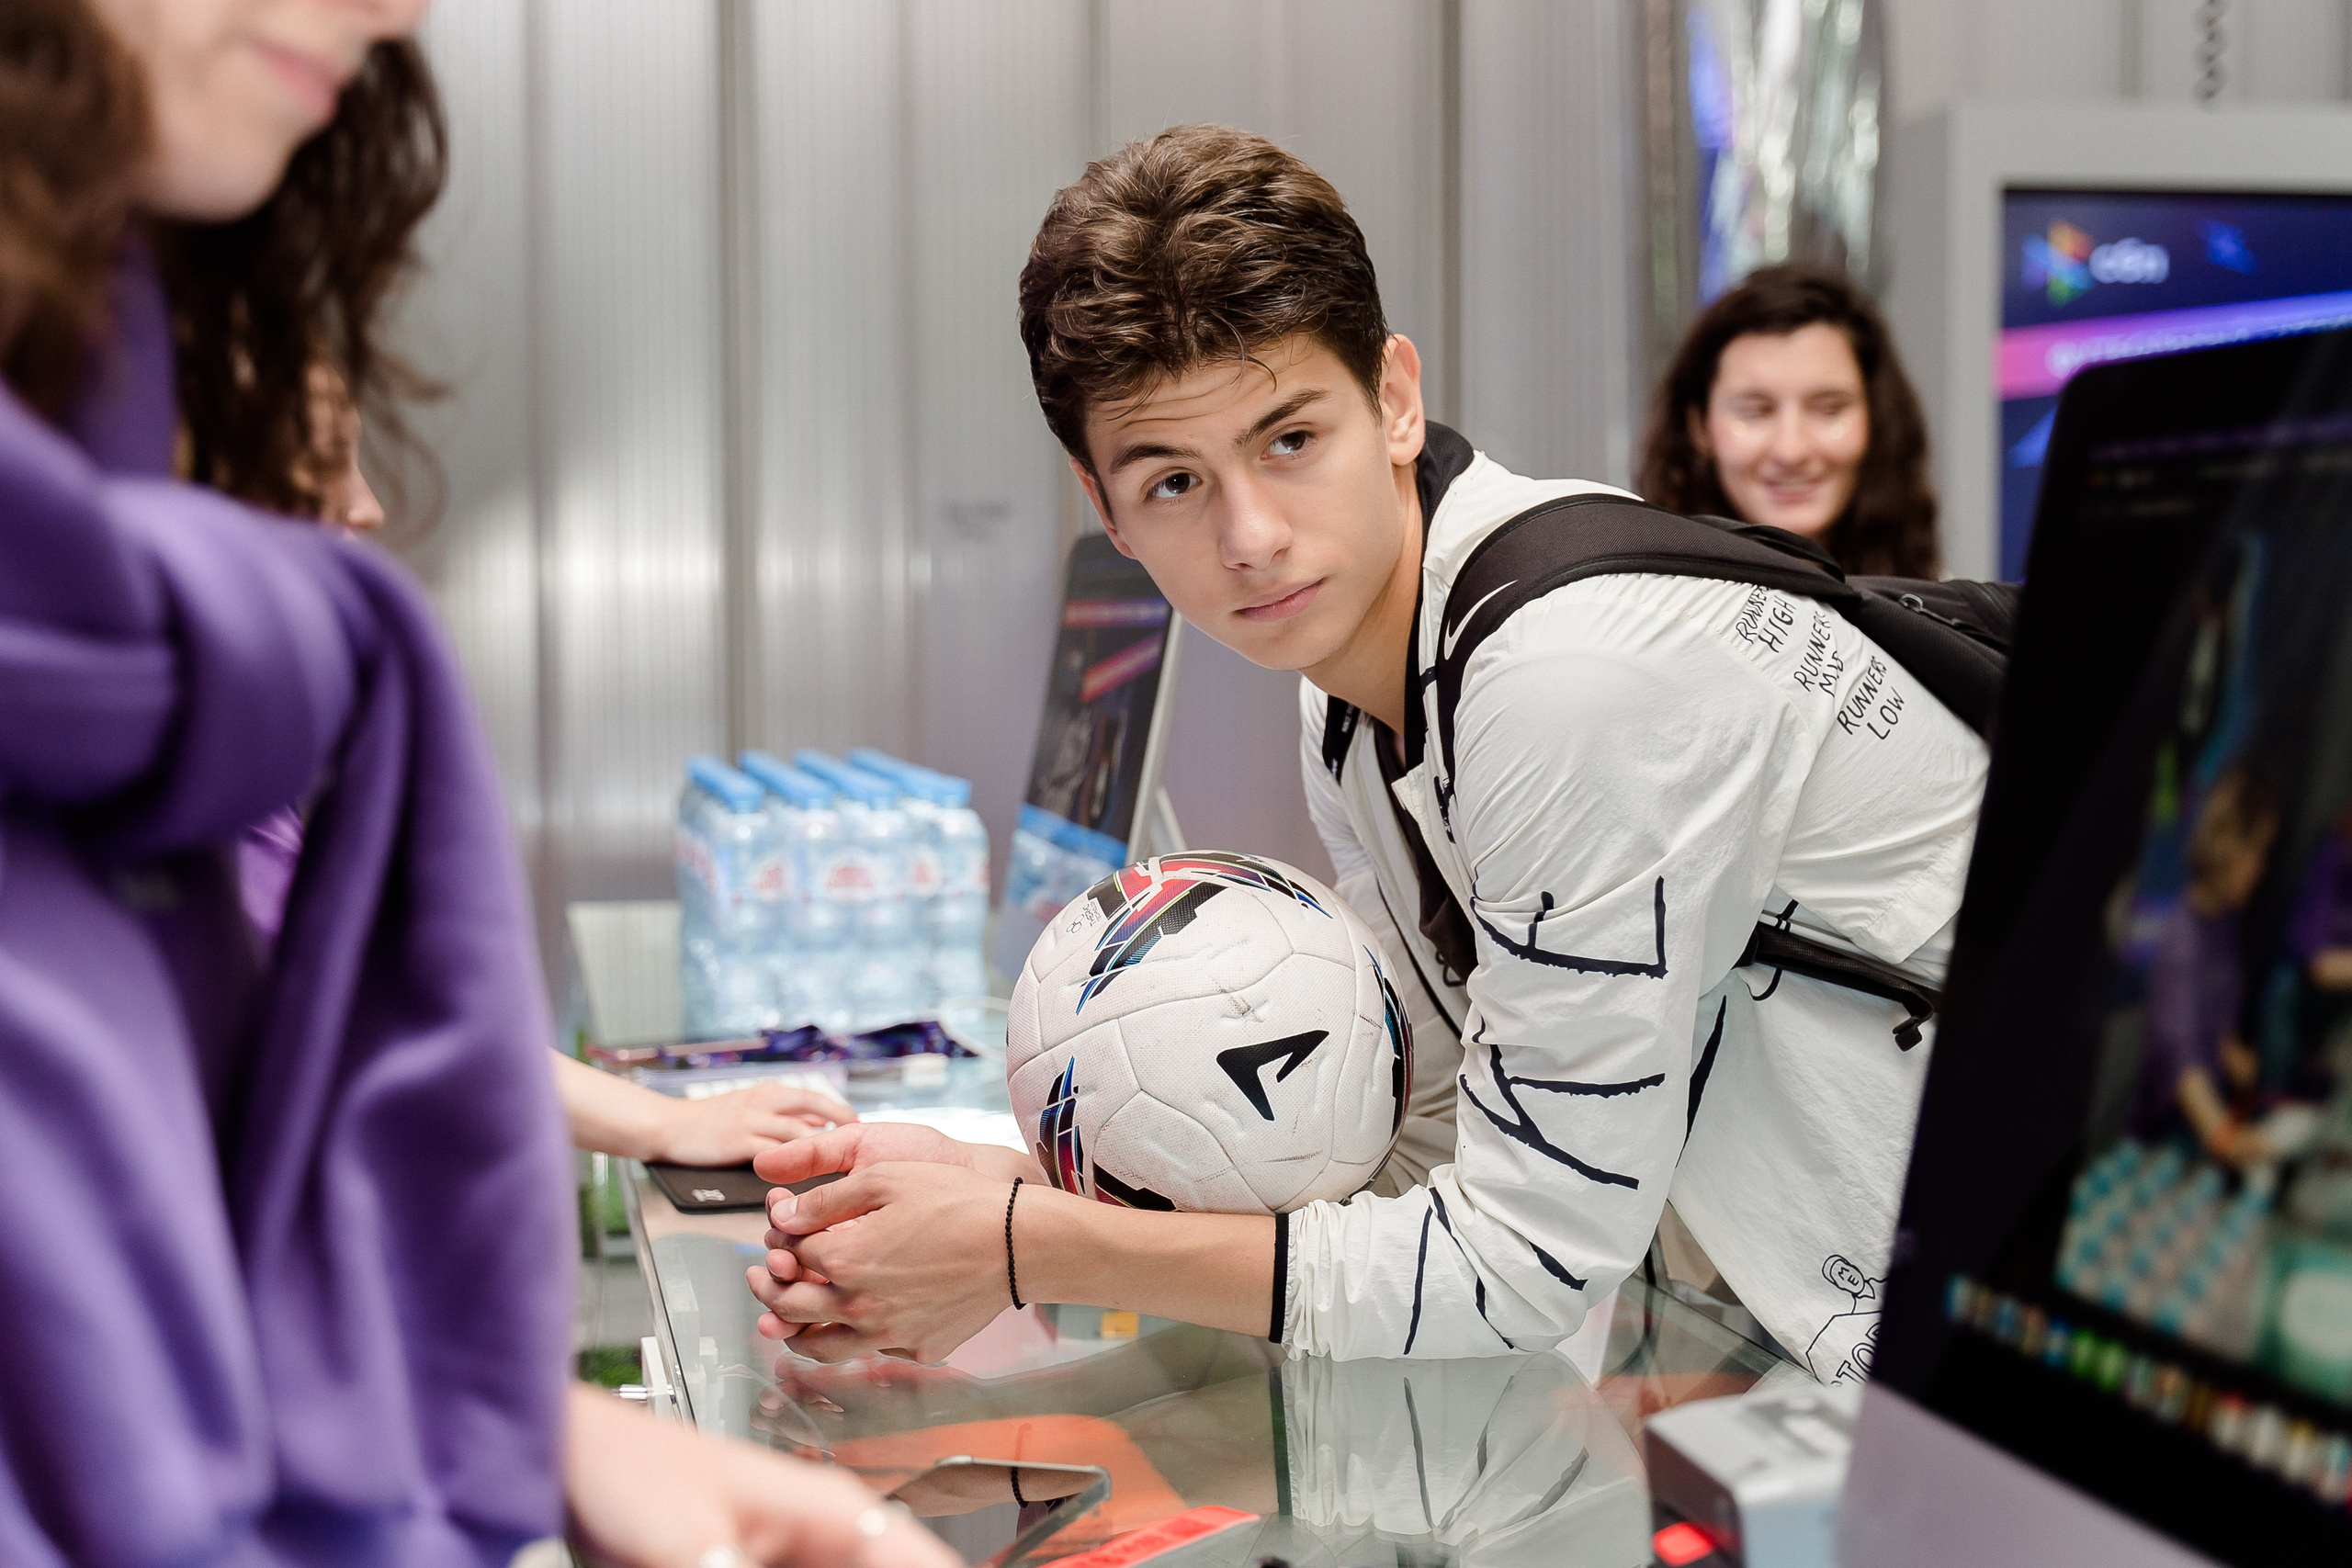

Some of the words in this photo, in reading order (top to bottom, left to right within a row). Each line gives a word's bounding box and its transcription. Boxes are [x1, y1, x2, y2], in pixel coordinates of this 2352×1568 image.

[1758, 594, 1797, 653] HIGH
[1837, 655, 1887, 735] RUNNERS
[1866, 686, 1905, 740] LOW
